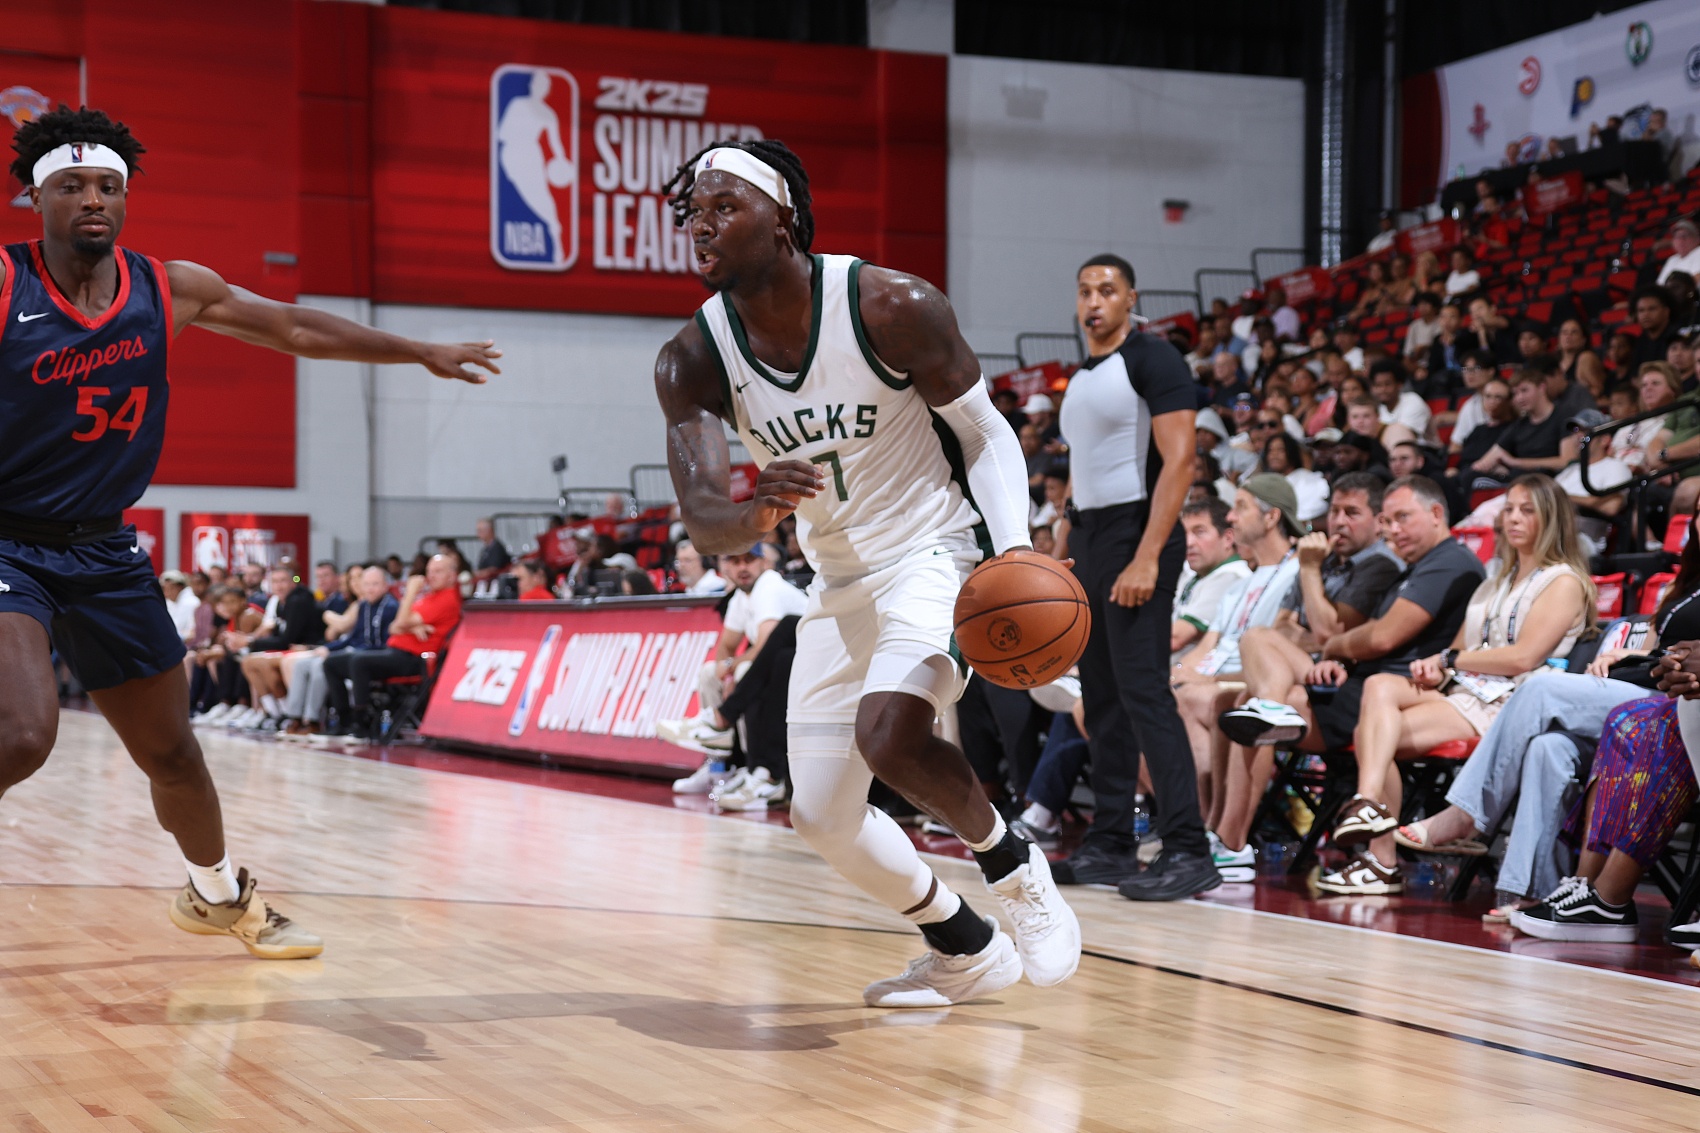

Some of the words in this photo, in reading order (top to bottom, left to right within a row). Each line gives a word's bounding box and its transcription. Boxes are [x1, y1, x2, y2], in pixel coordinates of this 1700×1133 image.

[595, 76, 708, 115] 2K25
[504, 221, 547, 255] NBA
[592, 191, 706, 275] LEAG
[31, 335, 149, 386] Clippers
[71, 385, 149, 442] 54
[749, 403, 878, 457] BUCKS
[809, 450, 849, 502] 7
[452, 648, 527, 706] 2K25
[537, 632, 643, 735] SUMMER
[611, 631, 719, 741] LEAGUE
